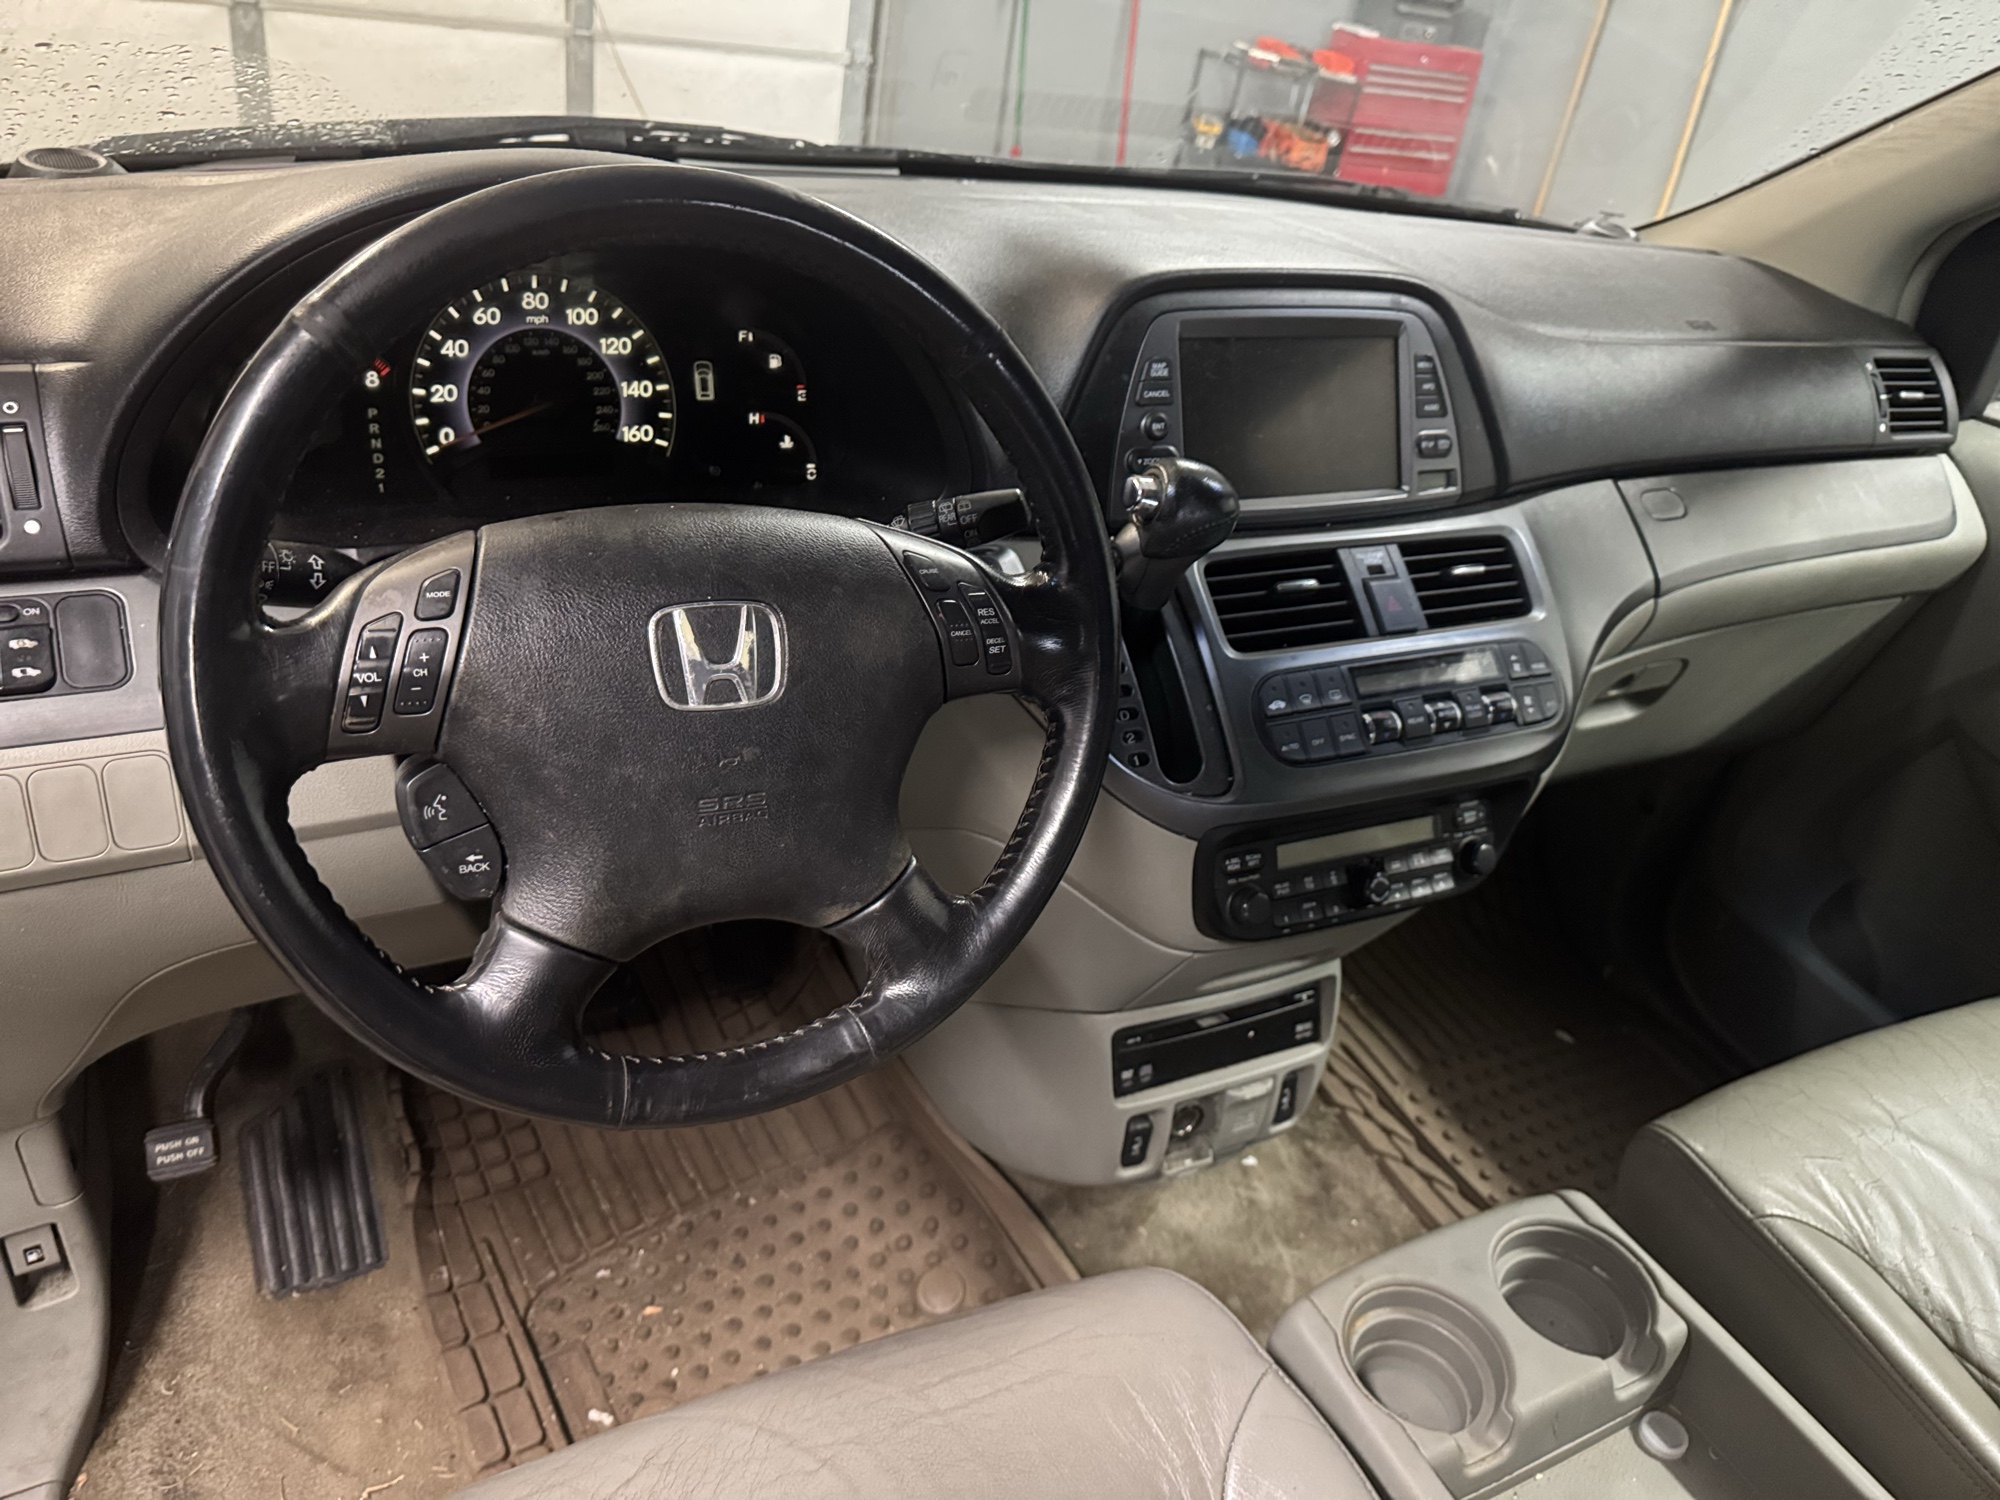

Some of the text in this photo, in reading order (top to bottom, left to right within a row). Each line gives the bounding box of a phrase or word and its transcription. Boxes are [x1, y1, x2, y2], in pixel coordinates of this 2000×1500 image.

[522, 292, 549, 309] 80
[473, 307, 501, 325] 60
[526, 314, 549, 324] mph
[566, 307, 598, 325] 100
[440, 339, 469, 357] 40
[600, 337, 632, 355] 120
[365, 371, 380, 388] 8
[430, 384, 458, 403] 20
[621, 380, 653, 398] 140
[1143, 390, 1170, 398] CANCEL
[1152, 422, 1165, 430] ENT
[439, 427, 455, 444] 0
[622, 425, 653, 443] 160
[368, 408, 385, 493] P R N D 2 1
[939, 512, 957, 524] REAR
[960, 513, 978, 525] OFF
[426, 591, 451, 599] MODE
[23, 607, 40, 616] ON
[977, 607, 996, 617] RES
[980, 617, 999, 625] ACCEL
[950, 629, 973, 637] CANCEL
[986, 637, 1006, 645] DECEL
[988, 644, 1007, 654] SET
[356, 672, 382, 684] VOL
[412, 668, 428, 677] CH
[1120, 710, 1130, 721] D
[1126, 733, 1135, 744] 2
[1311, 737, 1325, 746] OFF
[1281, 742, 1300, 751] AUTO
[1133, 755, 1140, 766] 1
[459, 861, 491, 874] BACK
[154, 1136, 199, 1153] PUSH ON
[156, 1146, 205, 1166] PUSH OFF
